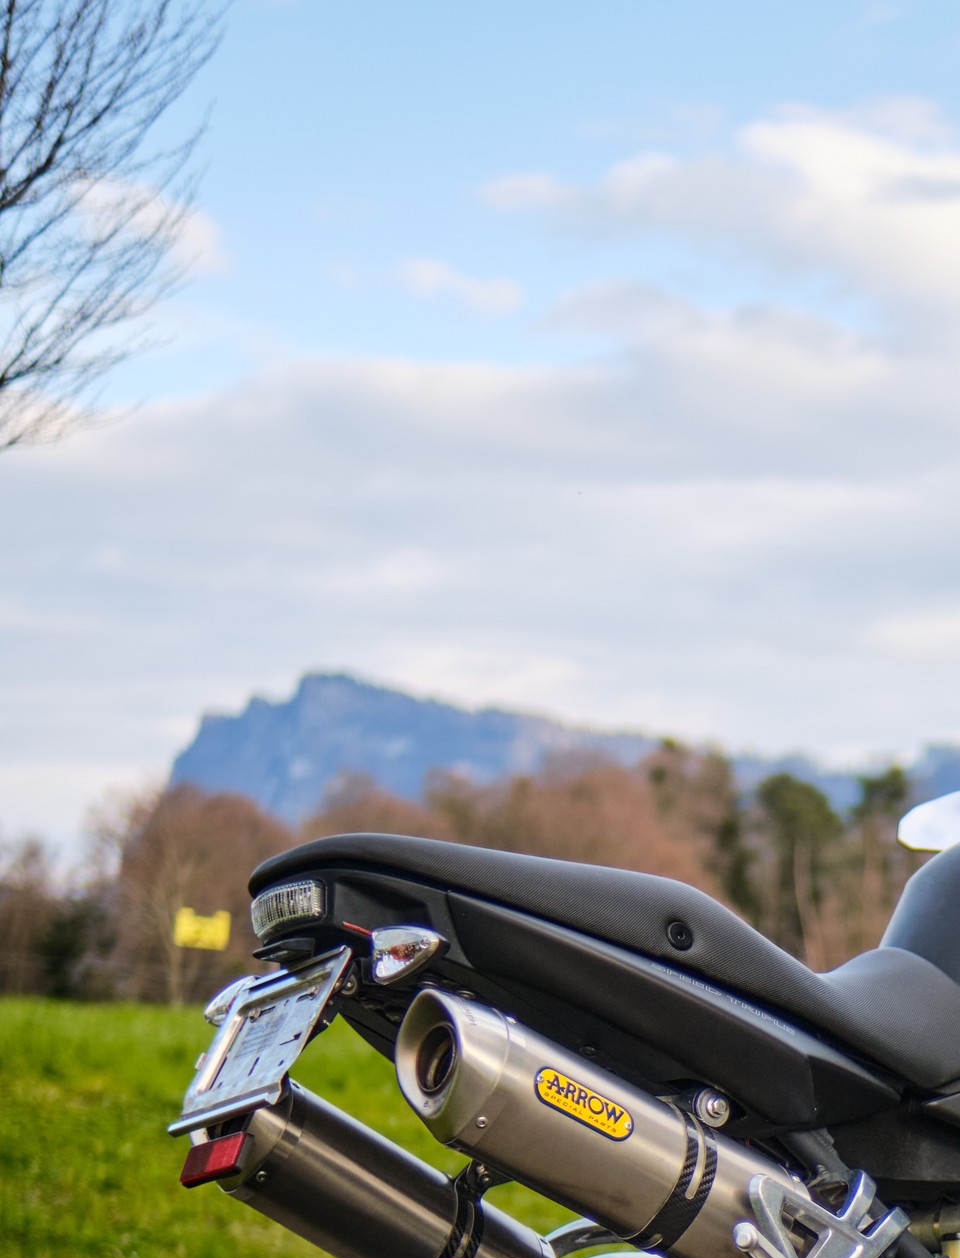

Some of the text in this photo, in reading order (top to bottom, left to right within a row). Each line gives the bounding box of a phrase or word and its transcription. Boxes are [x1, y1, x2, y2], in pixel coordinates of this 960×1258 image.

[650, 962, 796, 1036] SPEED TRIPLE
[543, 1092, 617, 1133] SPECIAL PARTS
[546, 1074, 624, 1125] ARROW
